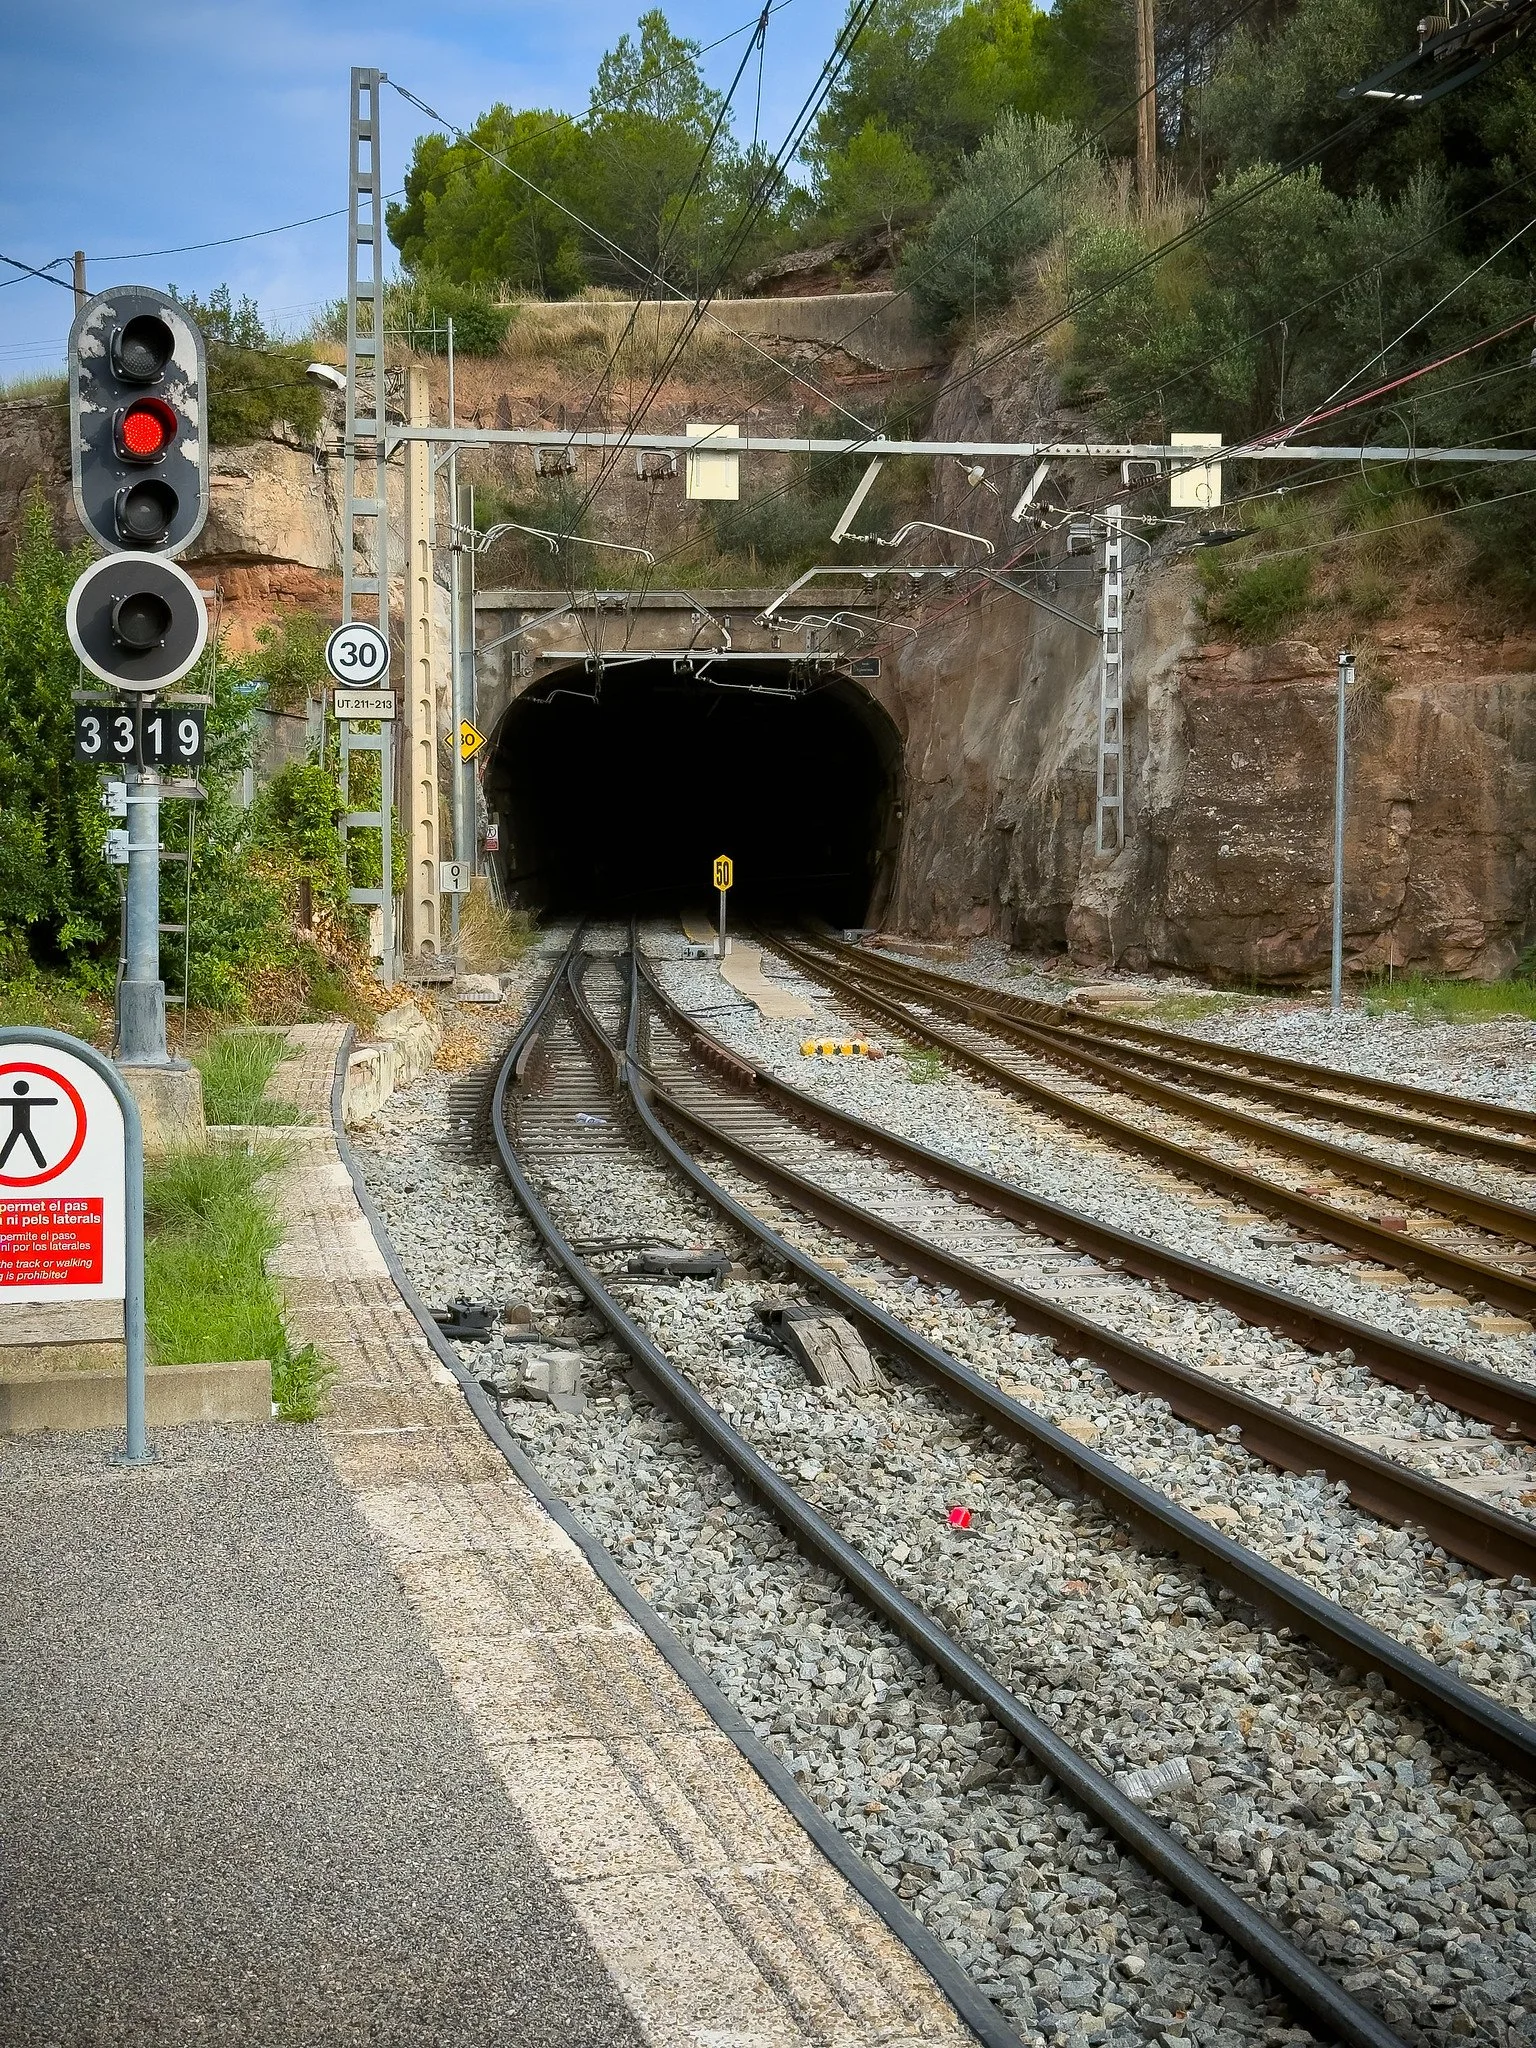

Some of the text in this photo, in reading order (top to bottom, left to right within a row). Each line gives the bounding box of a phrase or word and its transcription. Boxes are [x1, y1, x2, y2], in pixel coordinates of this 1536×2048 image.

[339, 641, 377, 668] 30
[337, 699, 393, 709] UT.211-213
[80, 716, 200, 756] 3319
[451, 865, 460, 876] 0
[716, 861, 729, 886] 50
[453, 878, 458, 889] 1
[846, 932, 852, 941] 2
[0, 1200, 88, 1214] permet el pas
[6, 1214, 18, 1225] ni
[22, 1213, 49, 1227] pels
[53, 1212, 101, 1225] laterals
[0, 1231, 76, 1243] permite el paso
[13, 1244, 30, 1253] por
[32, 1242, 47, 1251] los
[50, 1241, 91, 1250] laterales
[16, 1259, 40, 1268] track
[56, 1258, 93, 1268] walking
[6, 1270, 14, 1280] is
[17, 1270, 68, 1281] prohibited
